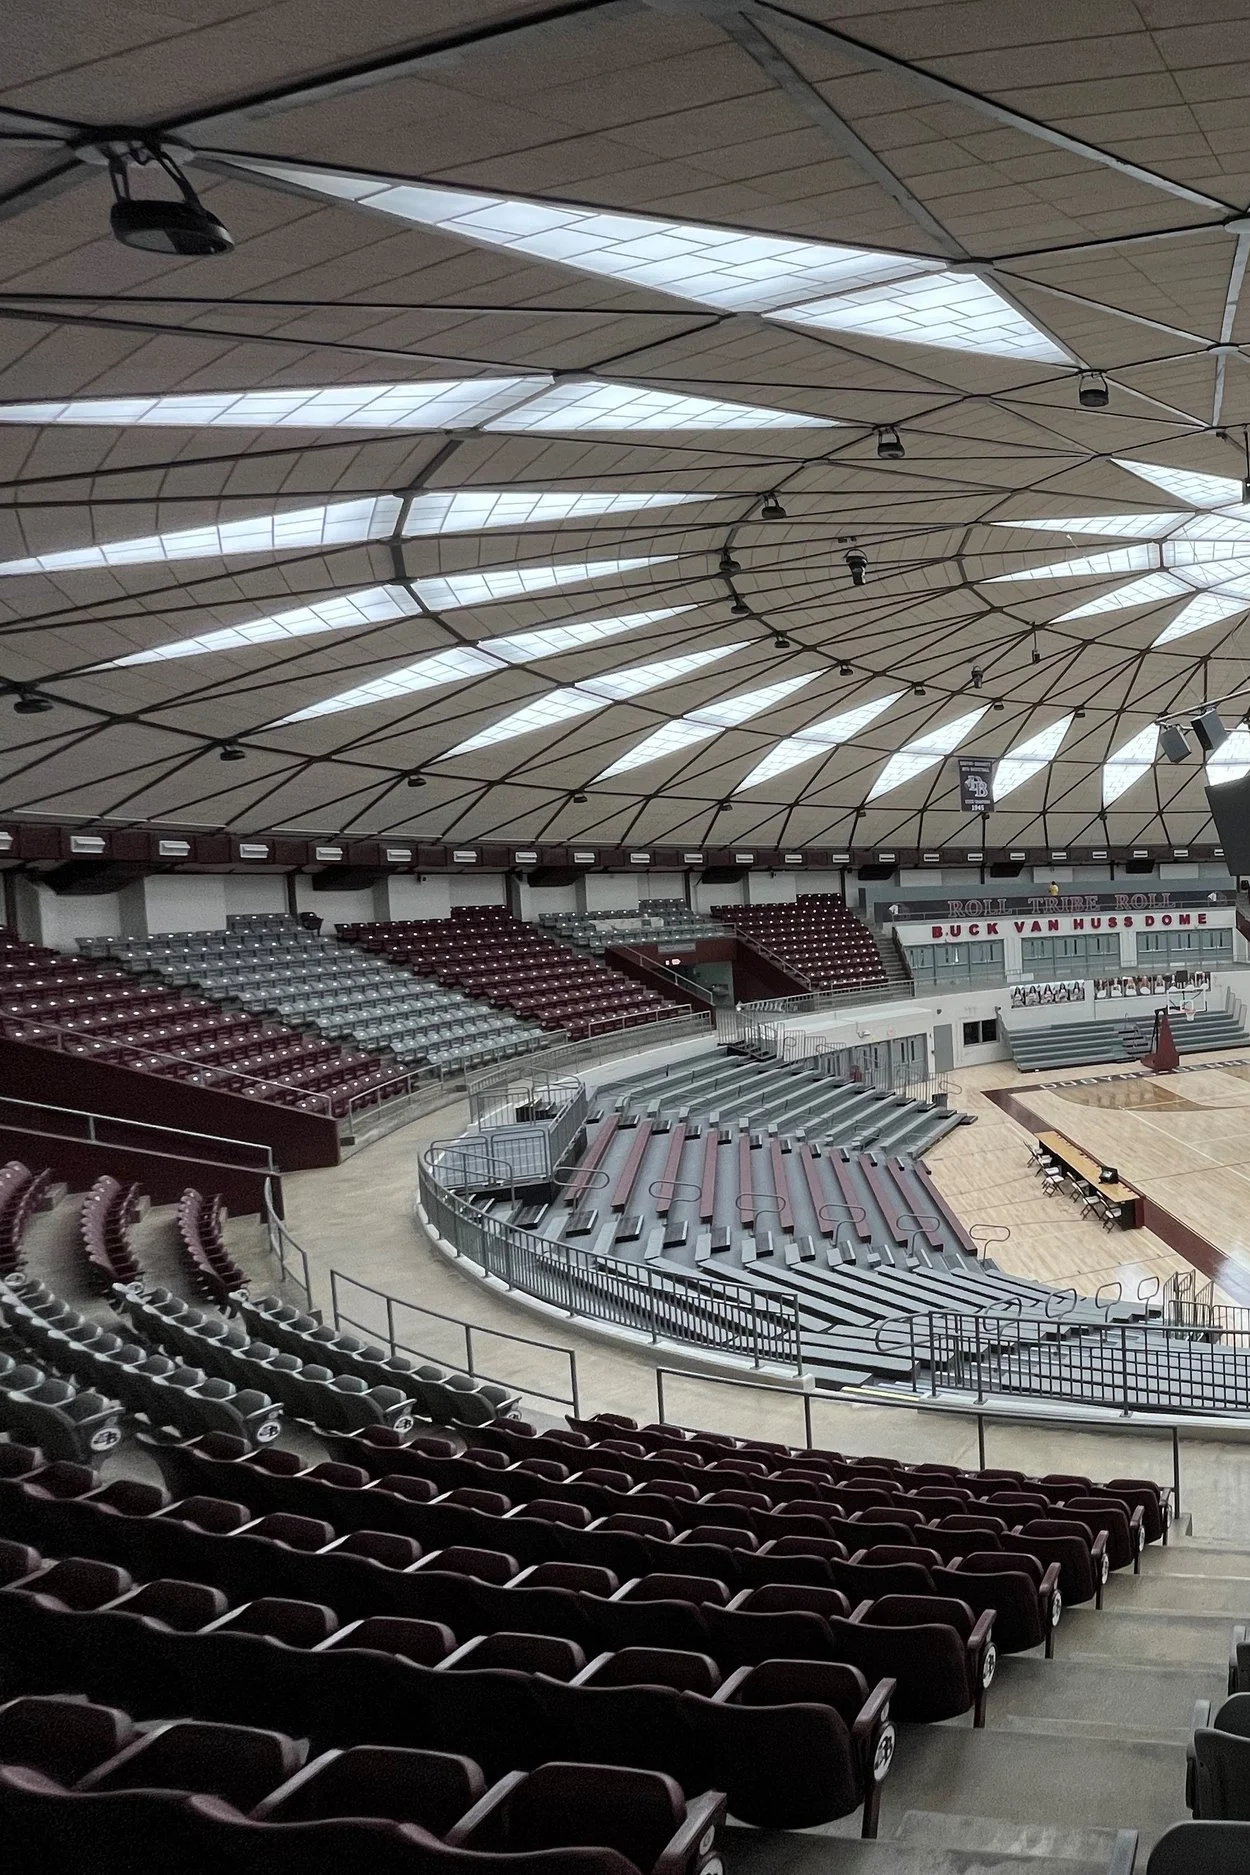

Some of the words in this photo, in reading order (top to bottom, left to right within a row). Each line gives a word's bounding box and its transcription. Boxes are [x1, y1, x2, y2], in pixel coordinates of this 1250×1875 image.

[947, 898, 1012, 918] ROLL
[1028, 894, 1101, 914] TRIBE
[1114, 892, 1176, 911] ROLL
[931, 921, 999, 939] BUCK
[1014, 918, 1060, 934] VAN
[1073, 916, 1134, 931] HUSS
[1144, 912, 1208, 928] DOME
